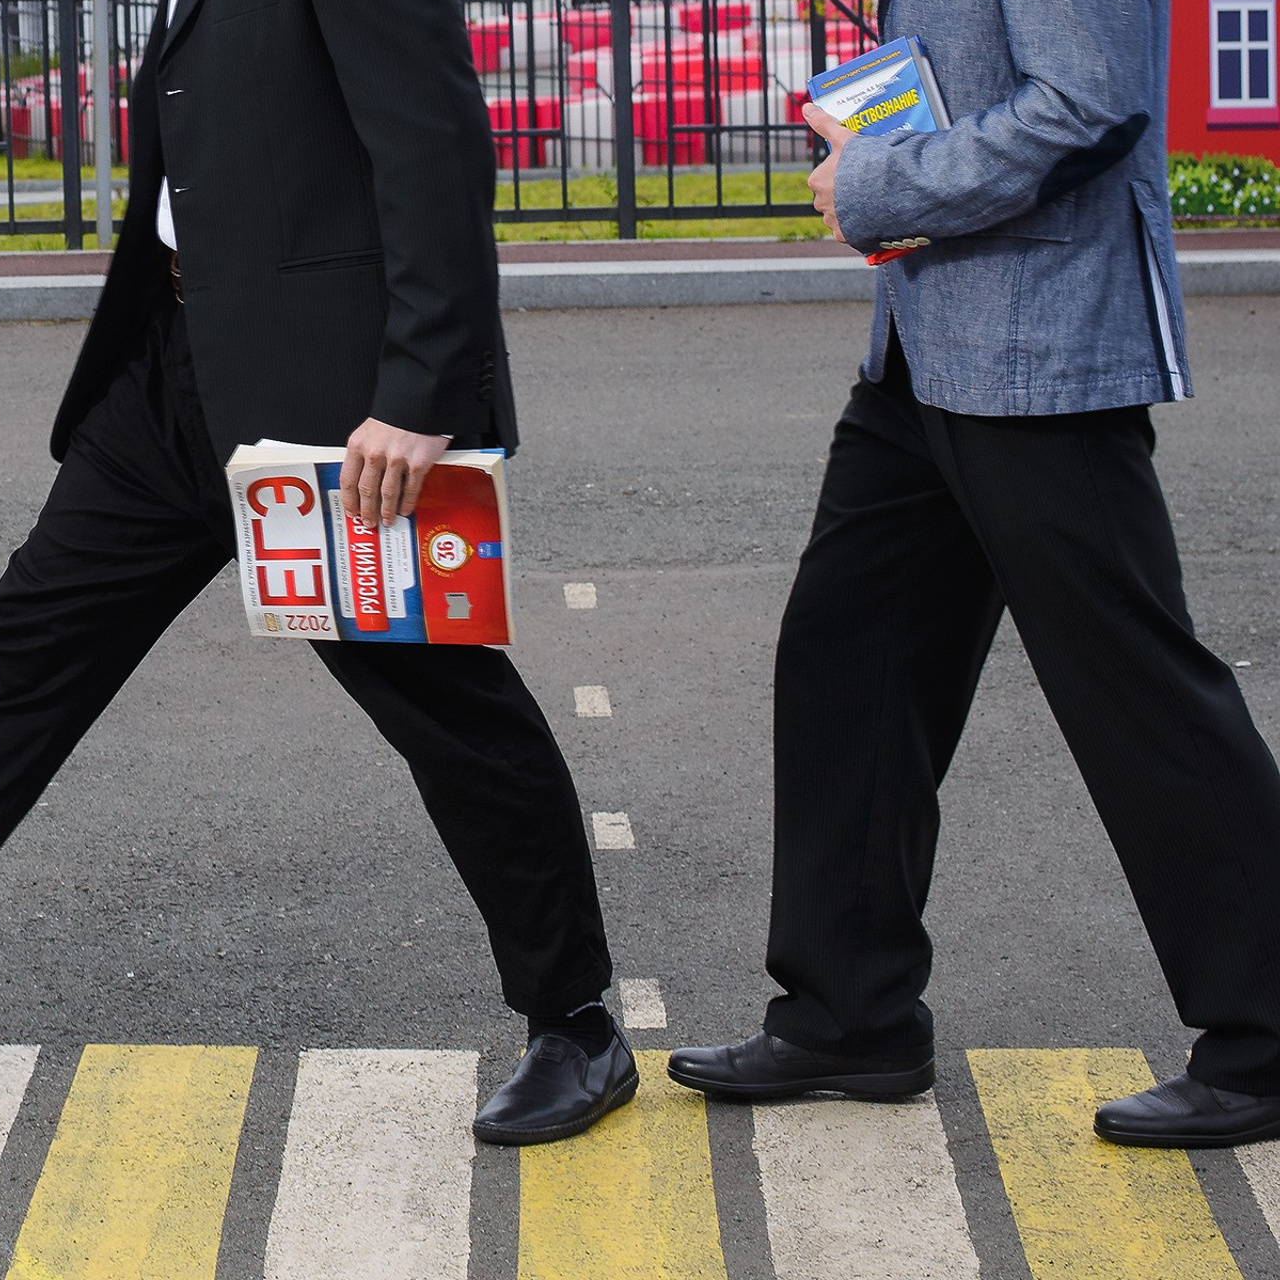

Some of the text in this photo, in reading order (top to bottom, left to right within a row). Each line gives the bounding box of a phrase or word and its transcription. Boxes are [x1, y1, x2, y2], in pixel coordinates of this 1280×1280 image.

[841, 89, 920, 132] ЩЕСТВОЗНАНИЕ
[246, 476, 326, 606] ЕГЭ
[333, 494, 351, 612] ЕДИНЫЙ ГОСУДАРСТВЕННЫЙ ЭКЗАМЕН
[436, 540, 456, 562] 36
[350, 541, 382, 614] РУССКИЙ
[285, 614, 331, 631] 2022
